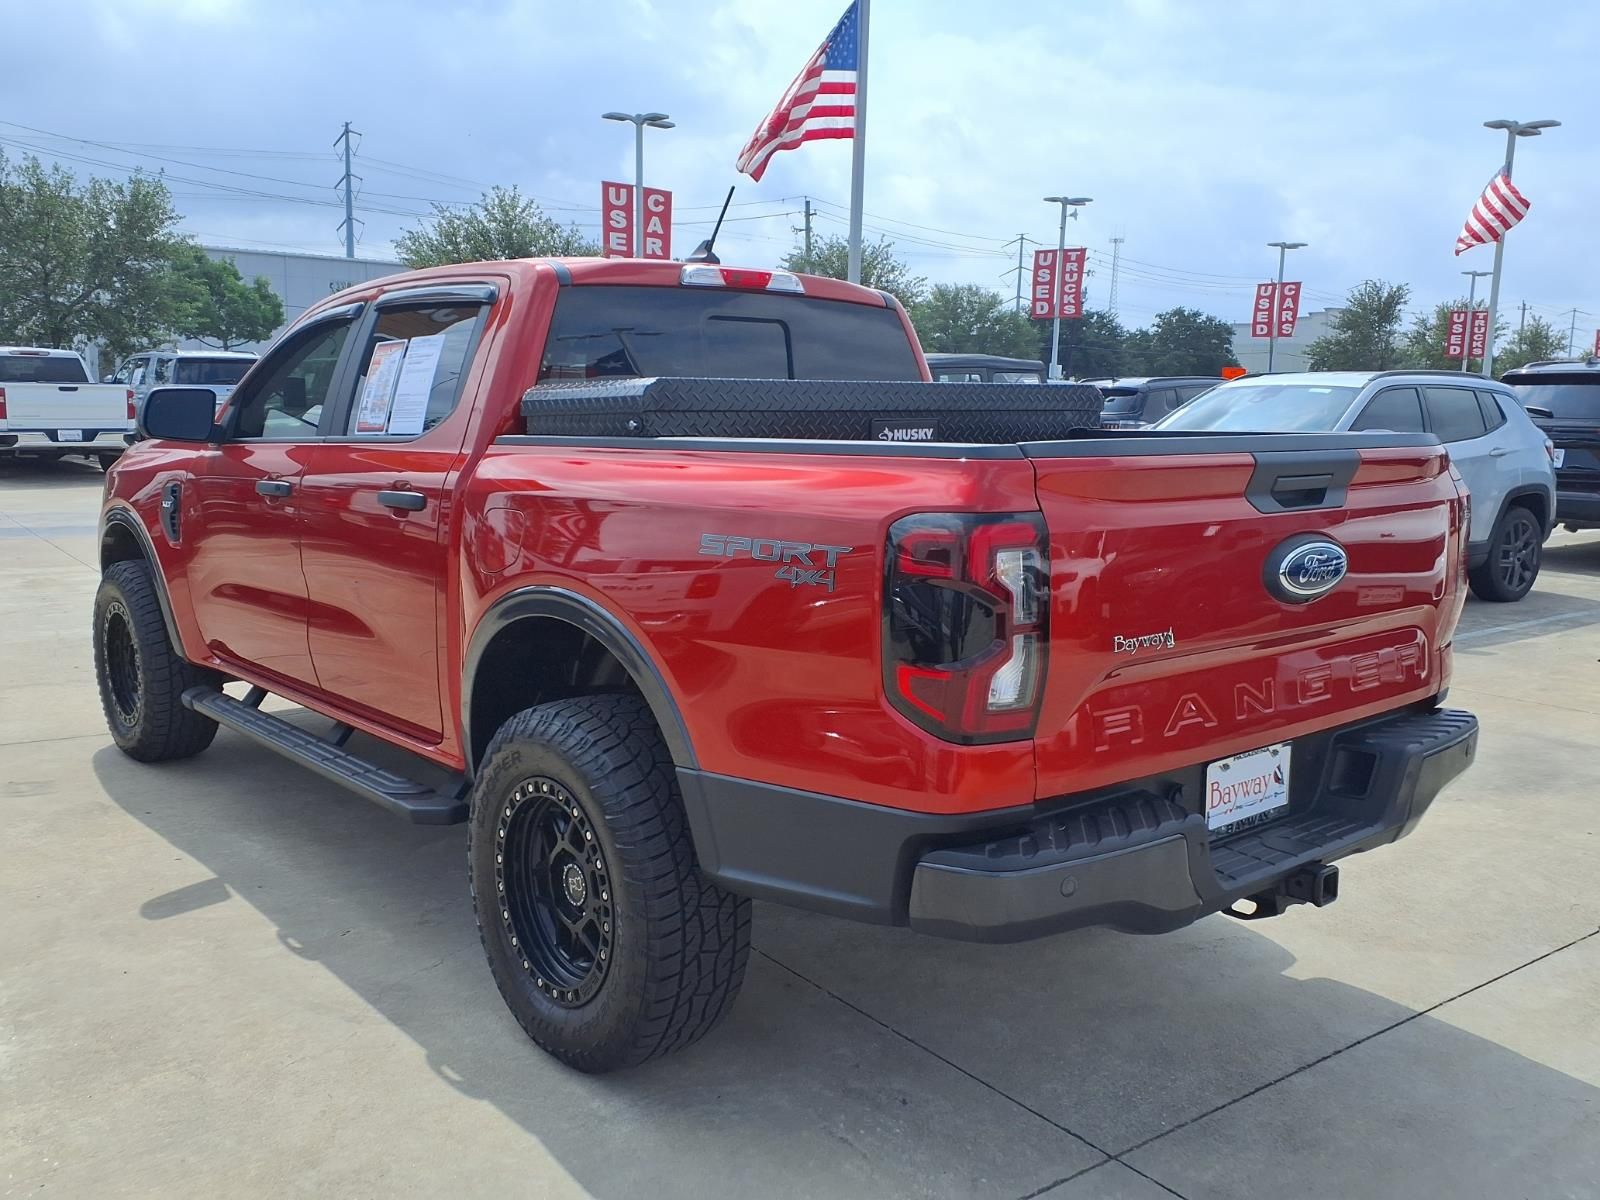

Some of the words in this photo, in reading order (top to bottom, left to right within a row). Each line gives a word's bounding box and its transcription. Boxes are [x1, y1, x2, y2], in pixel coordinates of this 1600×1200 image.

[609, 187, 627, 258] USE
[1036, 252, 1053, 315] USED
[1063, 252, 1080, 314] TRUCKS
[1256, 285, 1272, 334] USED
[1281, 285, 1296, 334] CARS
[1449, 313, 1465, 355] USED
[1472, 312, 1488, 355] TRUCKS
[893, 428, 934, 441] HUSKY
[699, 533, 854, 568] SPORT
[1299, 554, 1336, 583] Ford
[1093, 642, 1425, 752] RANGER
[1209, 773, 1272, 813] Bayway
